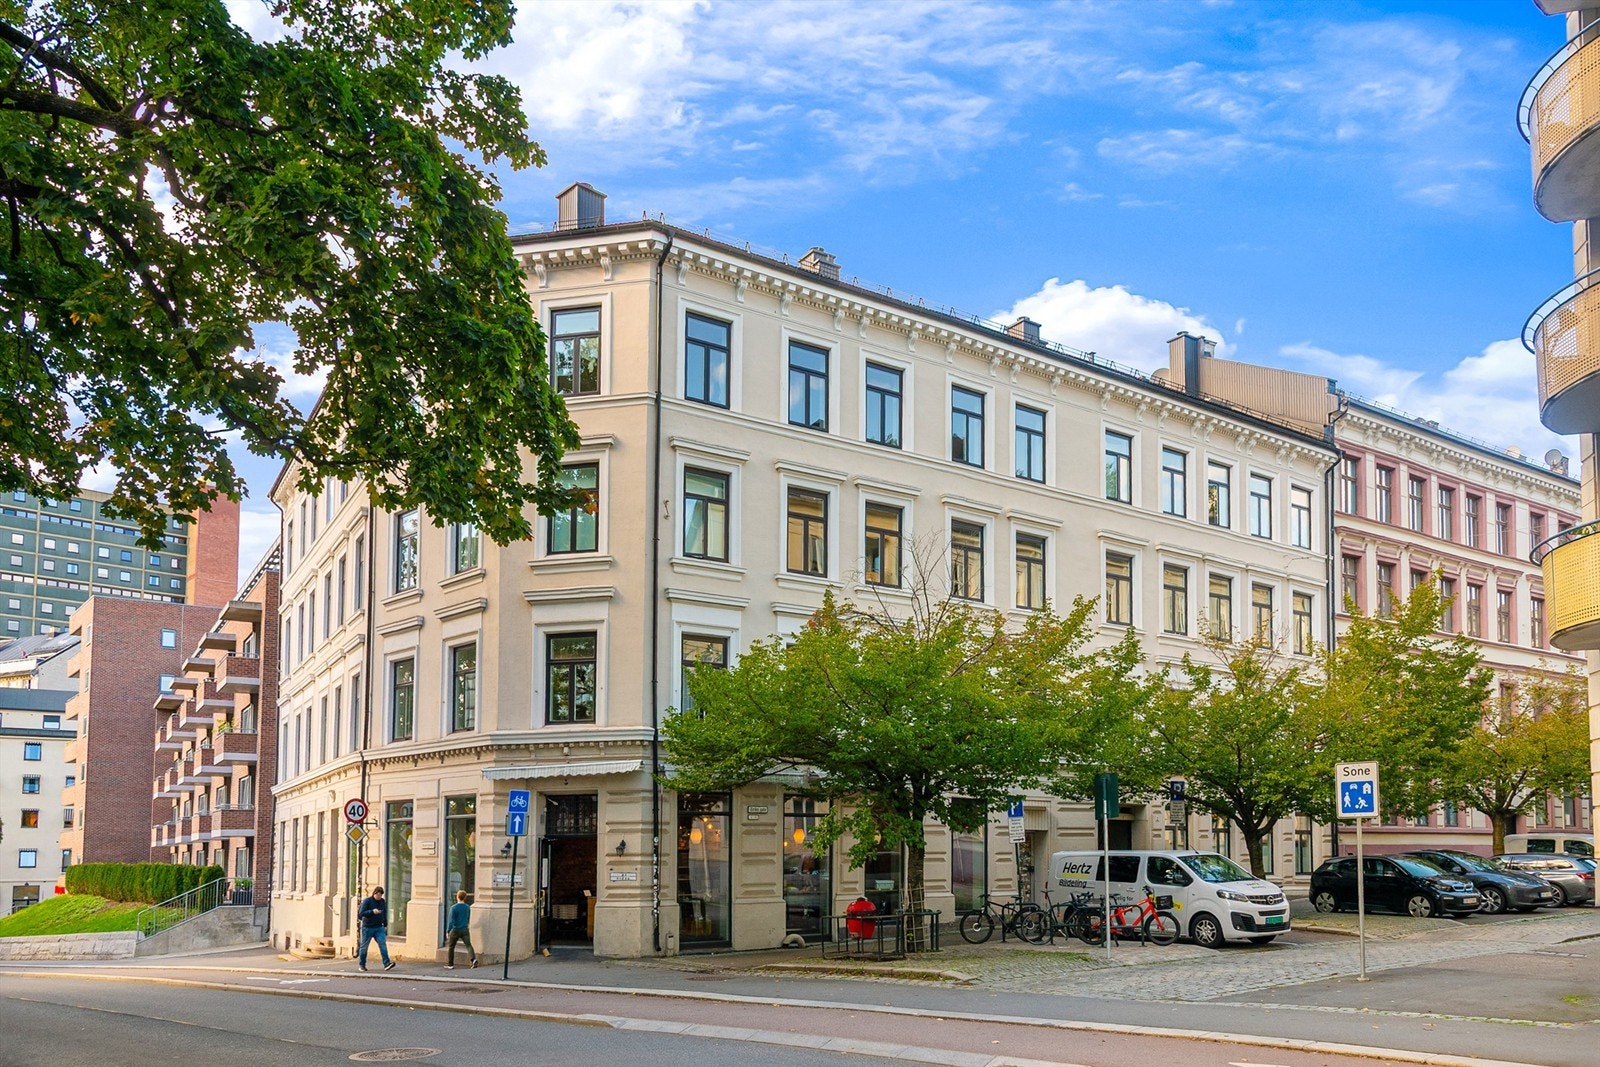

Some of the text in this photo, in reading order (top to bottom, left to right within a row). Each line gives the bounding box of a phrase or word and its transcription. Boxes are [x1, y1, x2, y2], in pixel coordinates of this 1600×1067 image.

[1343, 766, 1371, 777] Sone
[348, 805, 365, 817] 40
[1062, 861, 1092, 875] Hertz
[1059, 879, 1087, 889] Bildeling
